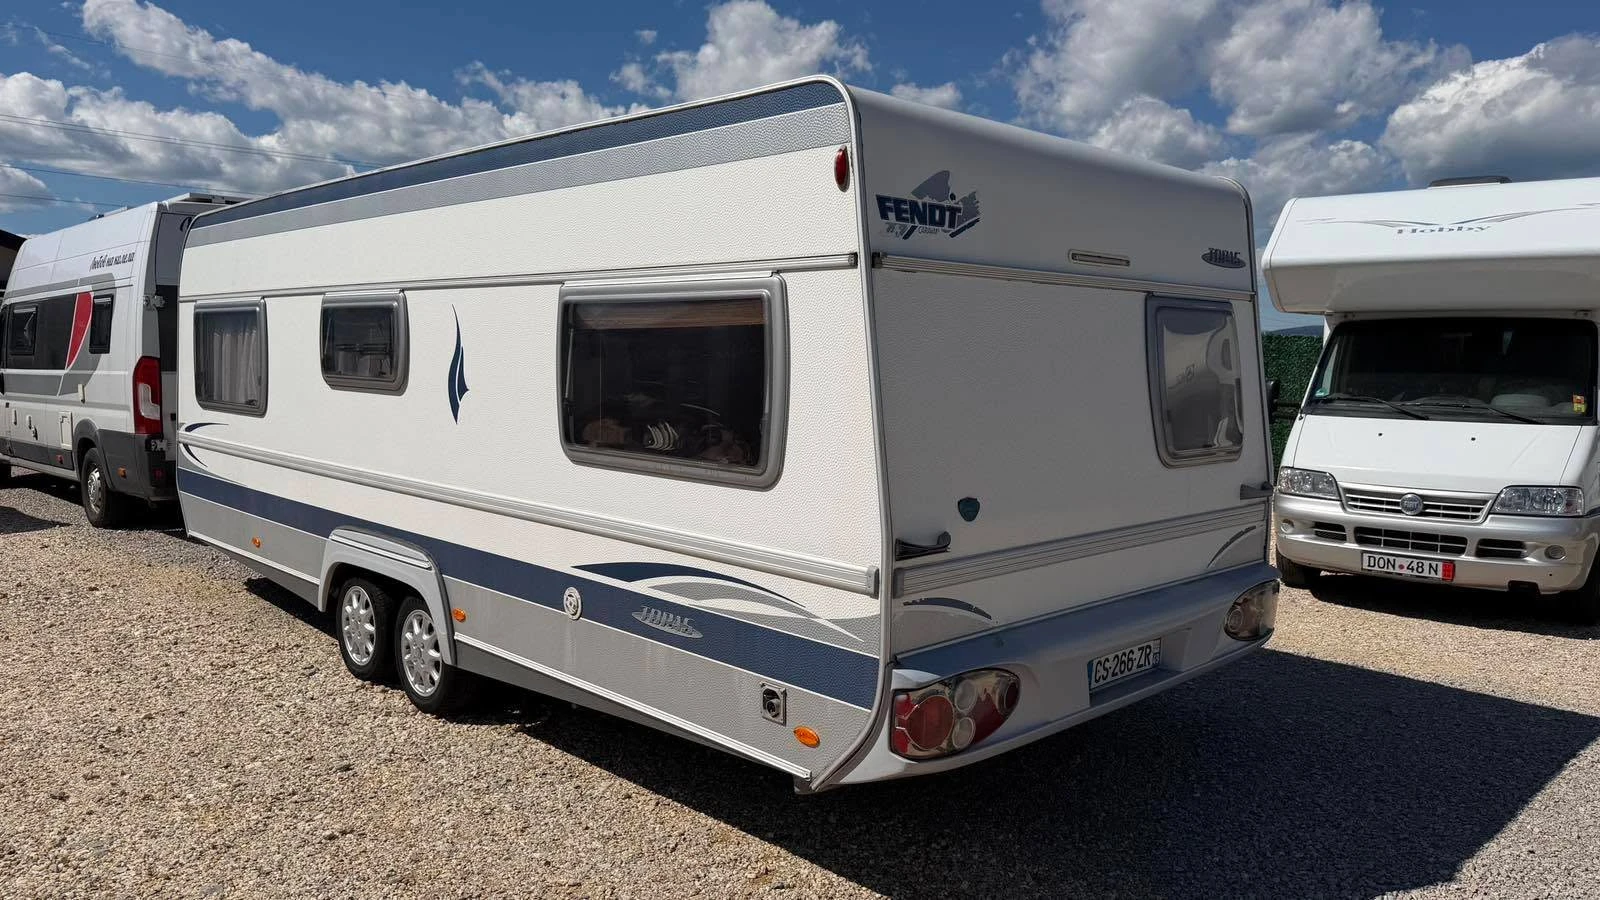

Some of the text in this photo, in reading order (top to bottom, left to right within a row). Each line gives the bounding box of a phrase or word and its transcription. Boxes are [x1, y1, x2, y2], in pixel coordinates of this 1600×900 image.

[876, 194, 962, 230] FENDT
[1397, 225, 1491, 234] Hobby
[1367, 555, 1396, 571] DON
[1406, 560, 1425, 574] 48
[1428, 562, 1438, 576] N
[1094, 644, 1152, 684] CS-266-ZR
